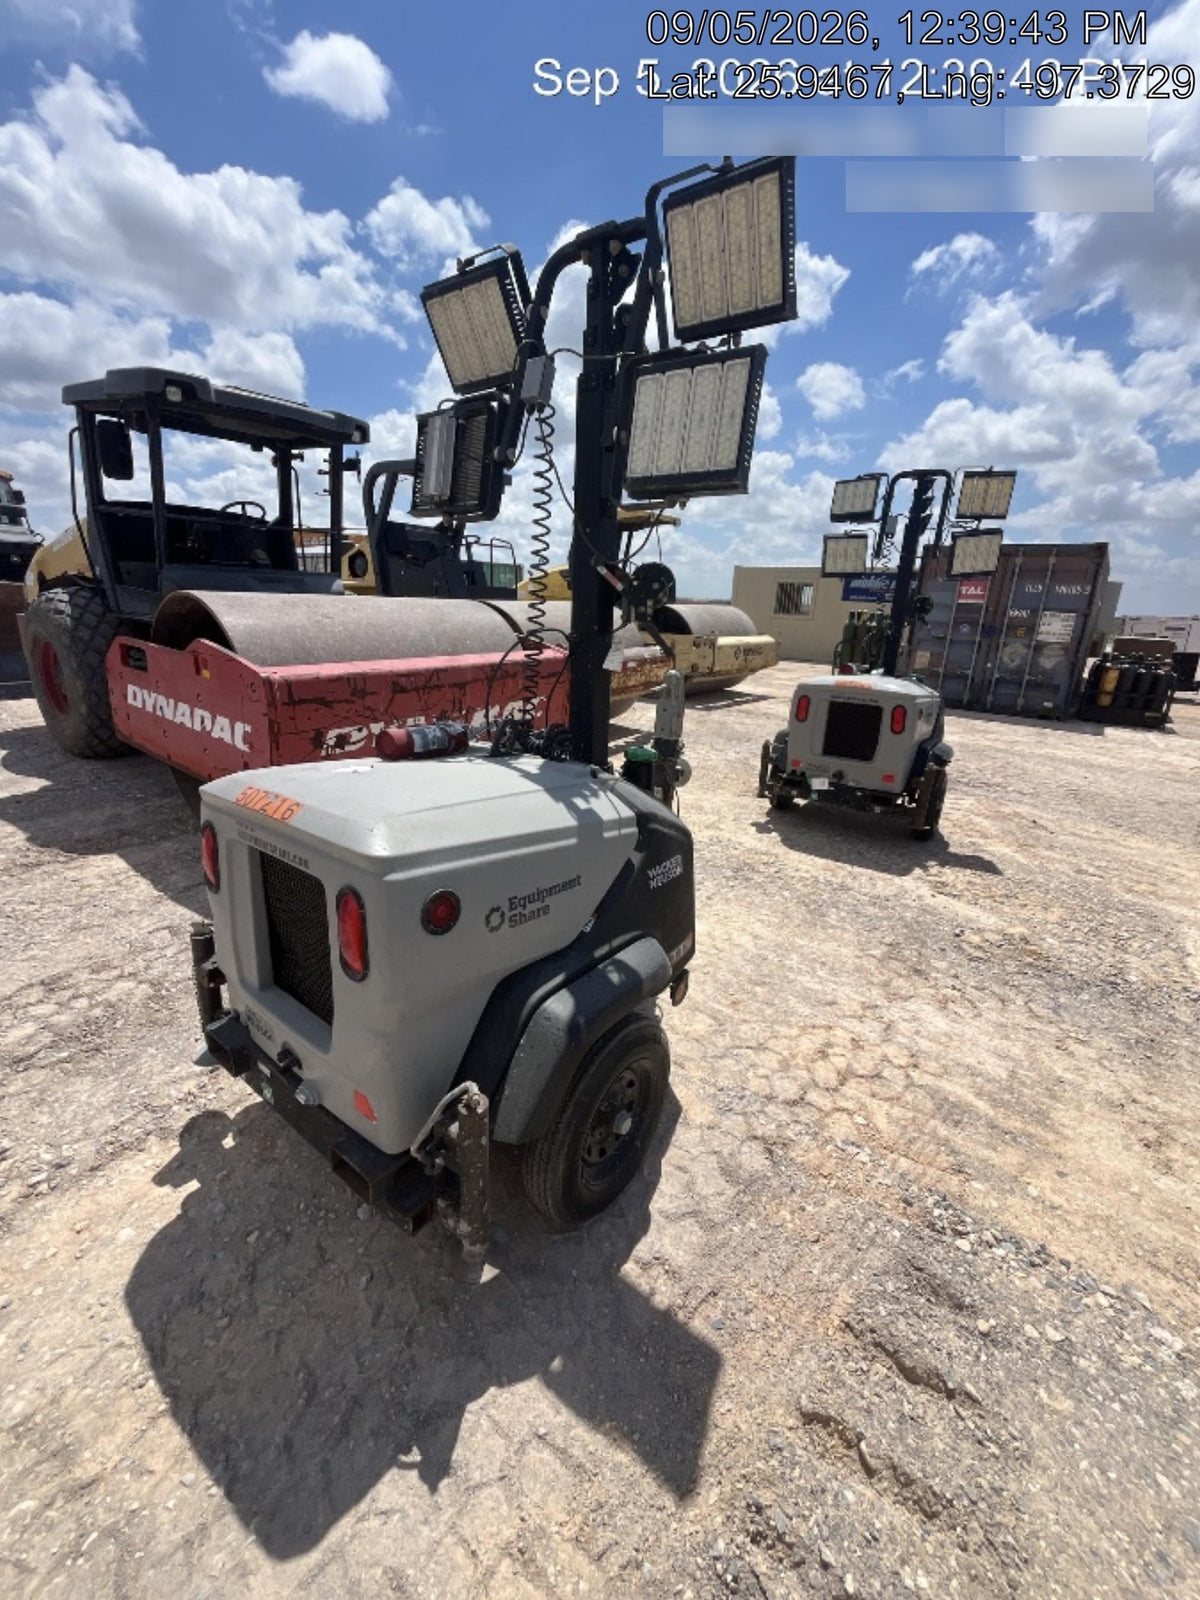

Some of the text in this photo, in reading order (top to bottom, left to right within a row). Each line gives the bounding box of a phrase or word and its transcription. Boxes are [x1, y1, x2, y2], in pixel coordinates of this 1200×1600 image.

[961, 585, 985, 595] TAL
[127, 683, 252, 753] DYNAPAC
[508, 874, 582, 912] Equipment
[508, 904, 550, 929] Share
